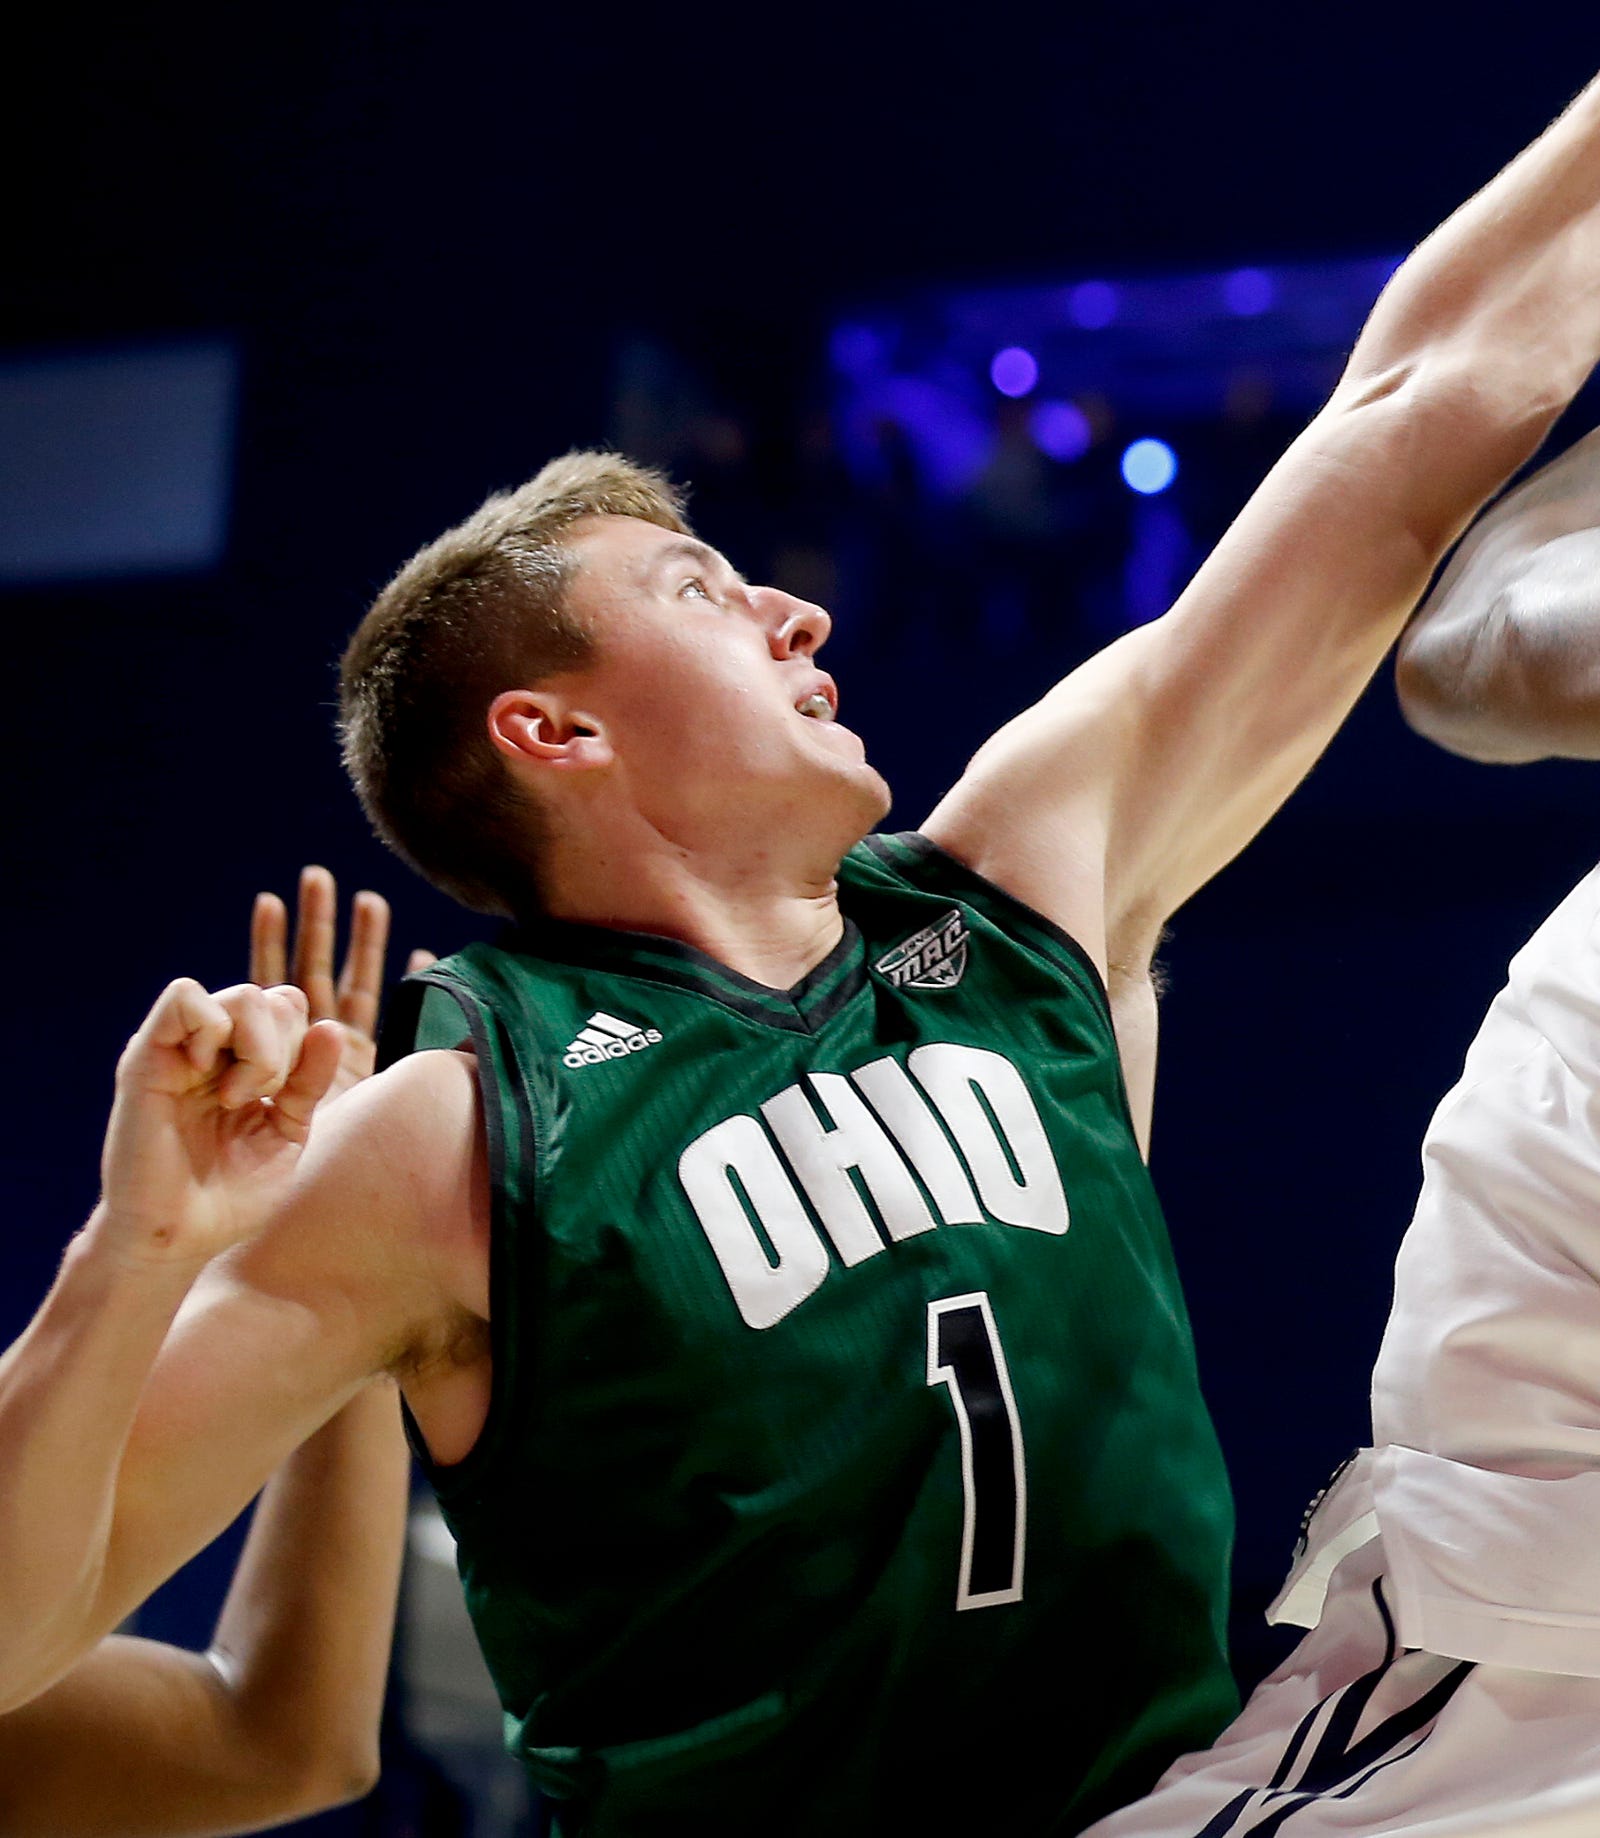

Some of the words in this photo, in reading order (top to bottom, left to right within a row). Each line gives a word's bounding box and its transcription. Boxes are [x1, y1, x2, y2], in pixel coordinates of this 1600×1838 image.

[889, 918, 970, 988] MAC
[562, 1028, 663, 1069] adidas
[678, 1042, 1070, 1330] OHIO
[926, 1290, 1028, 1611] 1
